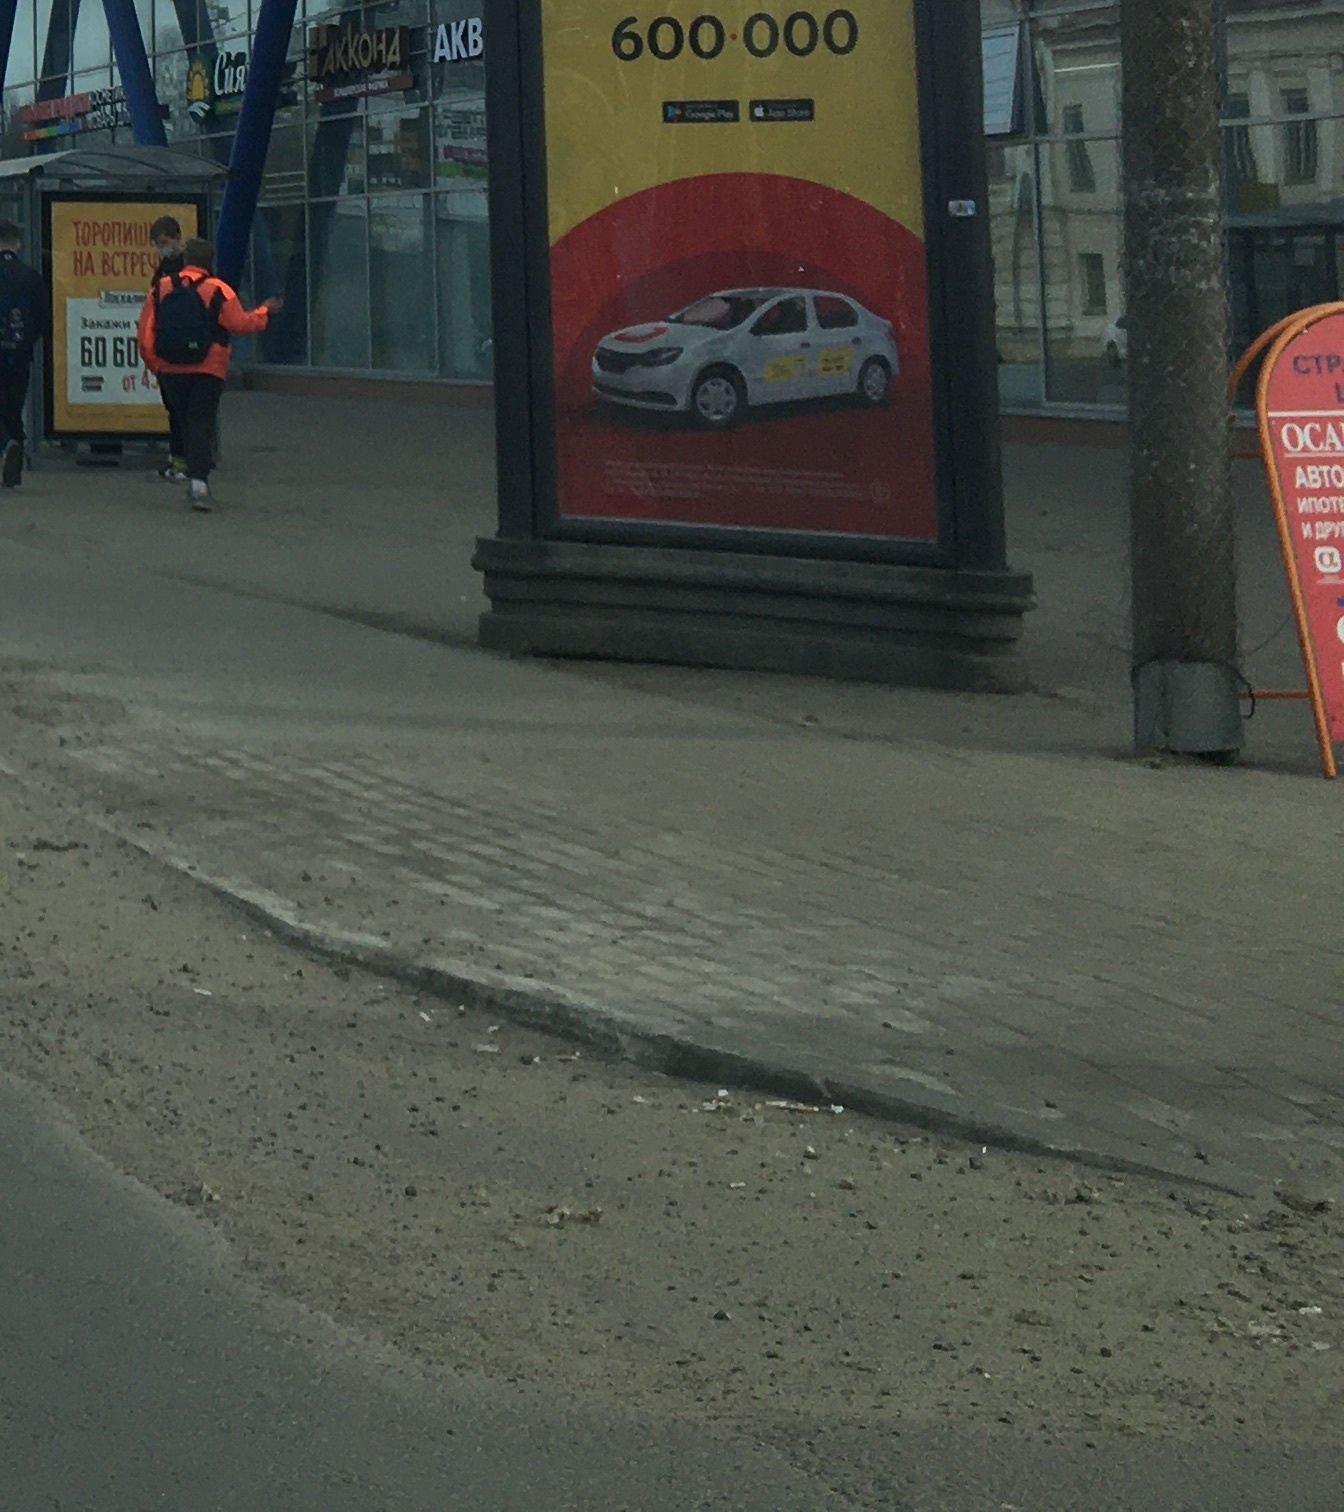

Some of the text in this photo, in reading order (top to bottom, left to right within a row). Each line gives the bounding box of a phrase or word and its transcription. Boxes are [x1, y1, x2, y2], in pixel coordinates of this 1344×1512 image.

[322, 24, 402, 76] АККОНД
[433, 16, 484, 64] АКВ
[214, 50, 252, 96] Сия
[72, 221, 154, 247] ТОРОПИШ
[73, 251, 95, 277] НА
[80, 316, 131, 330] Закажи
[80, 336, 107, 368] 60
[1293, 354, 1344, 375] СТР
[1295, 464, 1344, 489] АВТО
[1301, 521, 1313, 540] И
